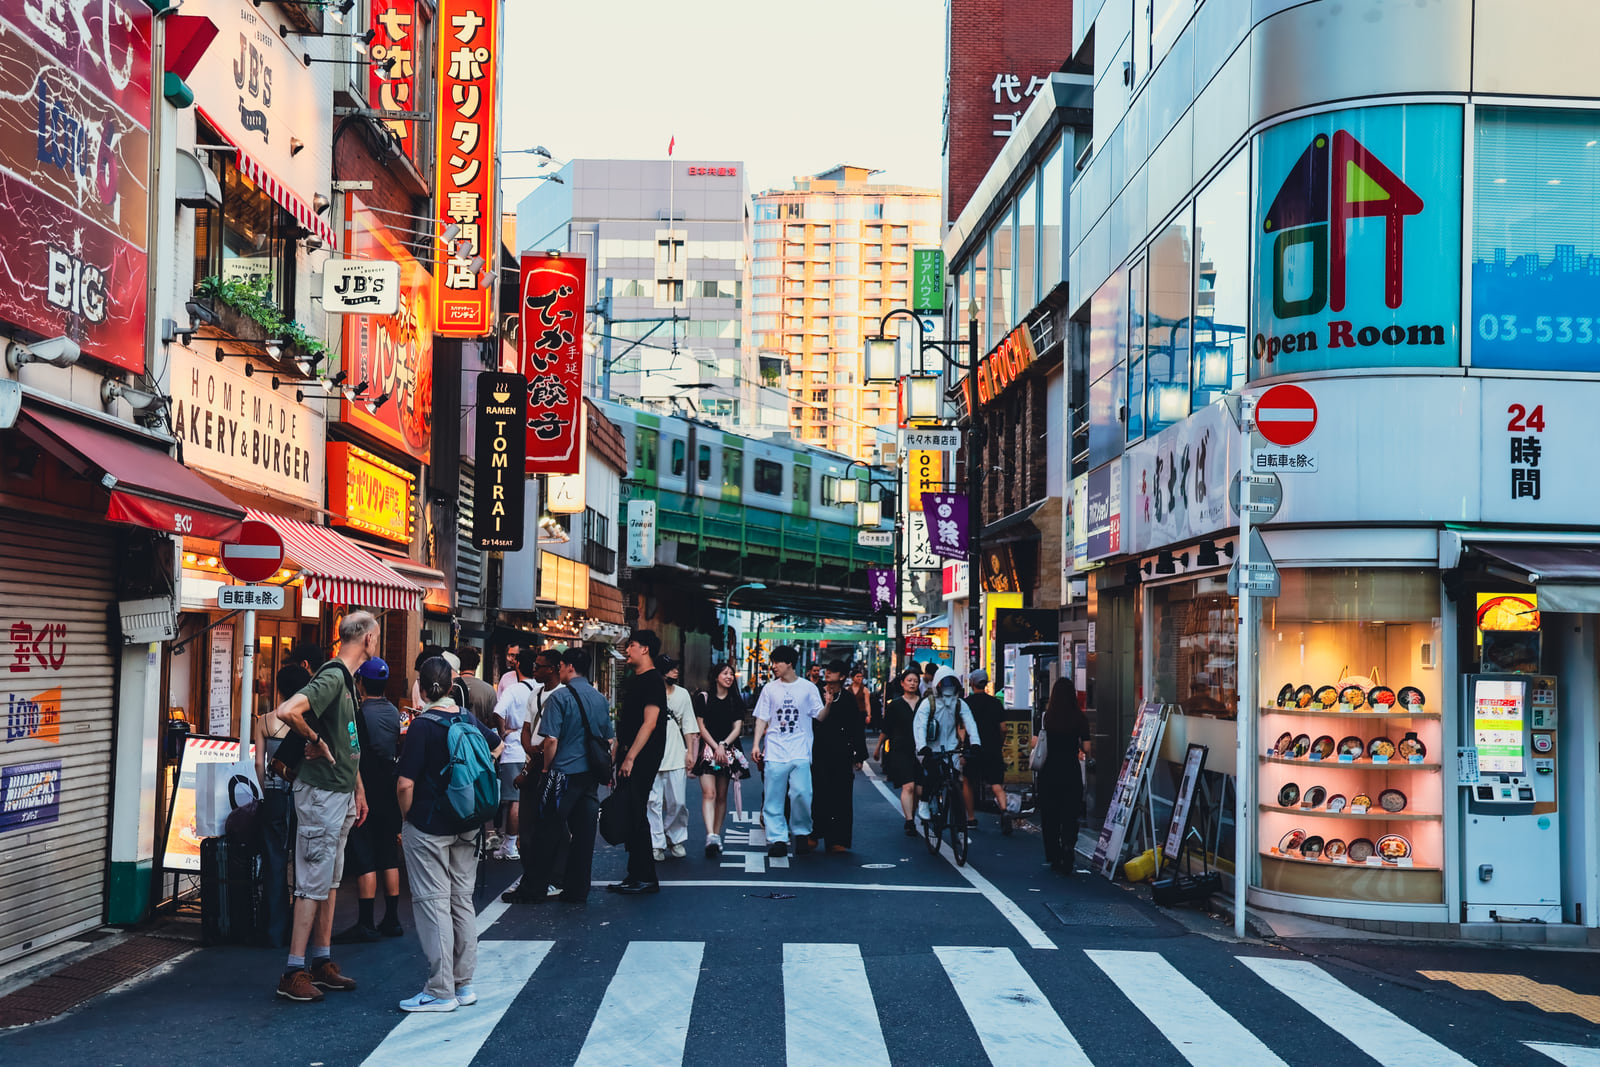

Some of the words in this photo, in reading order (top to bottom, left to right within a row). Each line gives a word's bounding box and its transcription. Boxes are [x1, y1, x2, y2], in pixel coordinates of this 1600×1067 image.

[241, 9, 257, 25] BAKERY
[257, 30, 273, 47] BURGER
[233, 32, 272, 108] JB'S
[37, 76, 88, 178] LOTO
[246, 114, 262, 126] TOKYO
[446, 10, 491, 290] ナポリタン専門店
[688, 166, 737, 176] 日本共産党
[48, 246, 106, 325] BIG
[334, 275, 385, 294] JB'S
[920, 251, 933, 308] リアハウス
[450, 310, 474, 319] パンチョ
[1479, 313, 1600, 344] 03-533
[1254, 331, 1318, 363] Open
[1327, 320, 1445, 348] Room
[526, 284, 575, 441] でっかい餃子
[191, 367, 296, 439] HOMEMADE
[485, 406, 516, 415] RAMEN
[175, 400, 238, 457] AKERY
[240, 431, 248, 457] &
[252, 429, 310, 483] BURGER
[907, 434, 957, 446] 代々木商店街
[491, 421, 508, 532] TOMIRAI
[1257, 454, 1314, 468] 自転車を除く
[174, 513, 193, 533] 宝くじ
[937, 519, 960, 548] 祭
[481, 538, 490, 546] 2F
[490, 538, 513, 546] 14SEAT
[914, 519, 925, 565] ラーメン
[223, 590, 279, 605] 自転車を除く
[9, 620, 67, 673] 宝くじ
[6, 692, 39, 744] LOTO
[3, 770, 58, 812] NUMBERS
